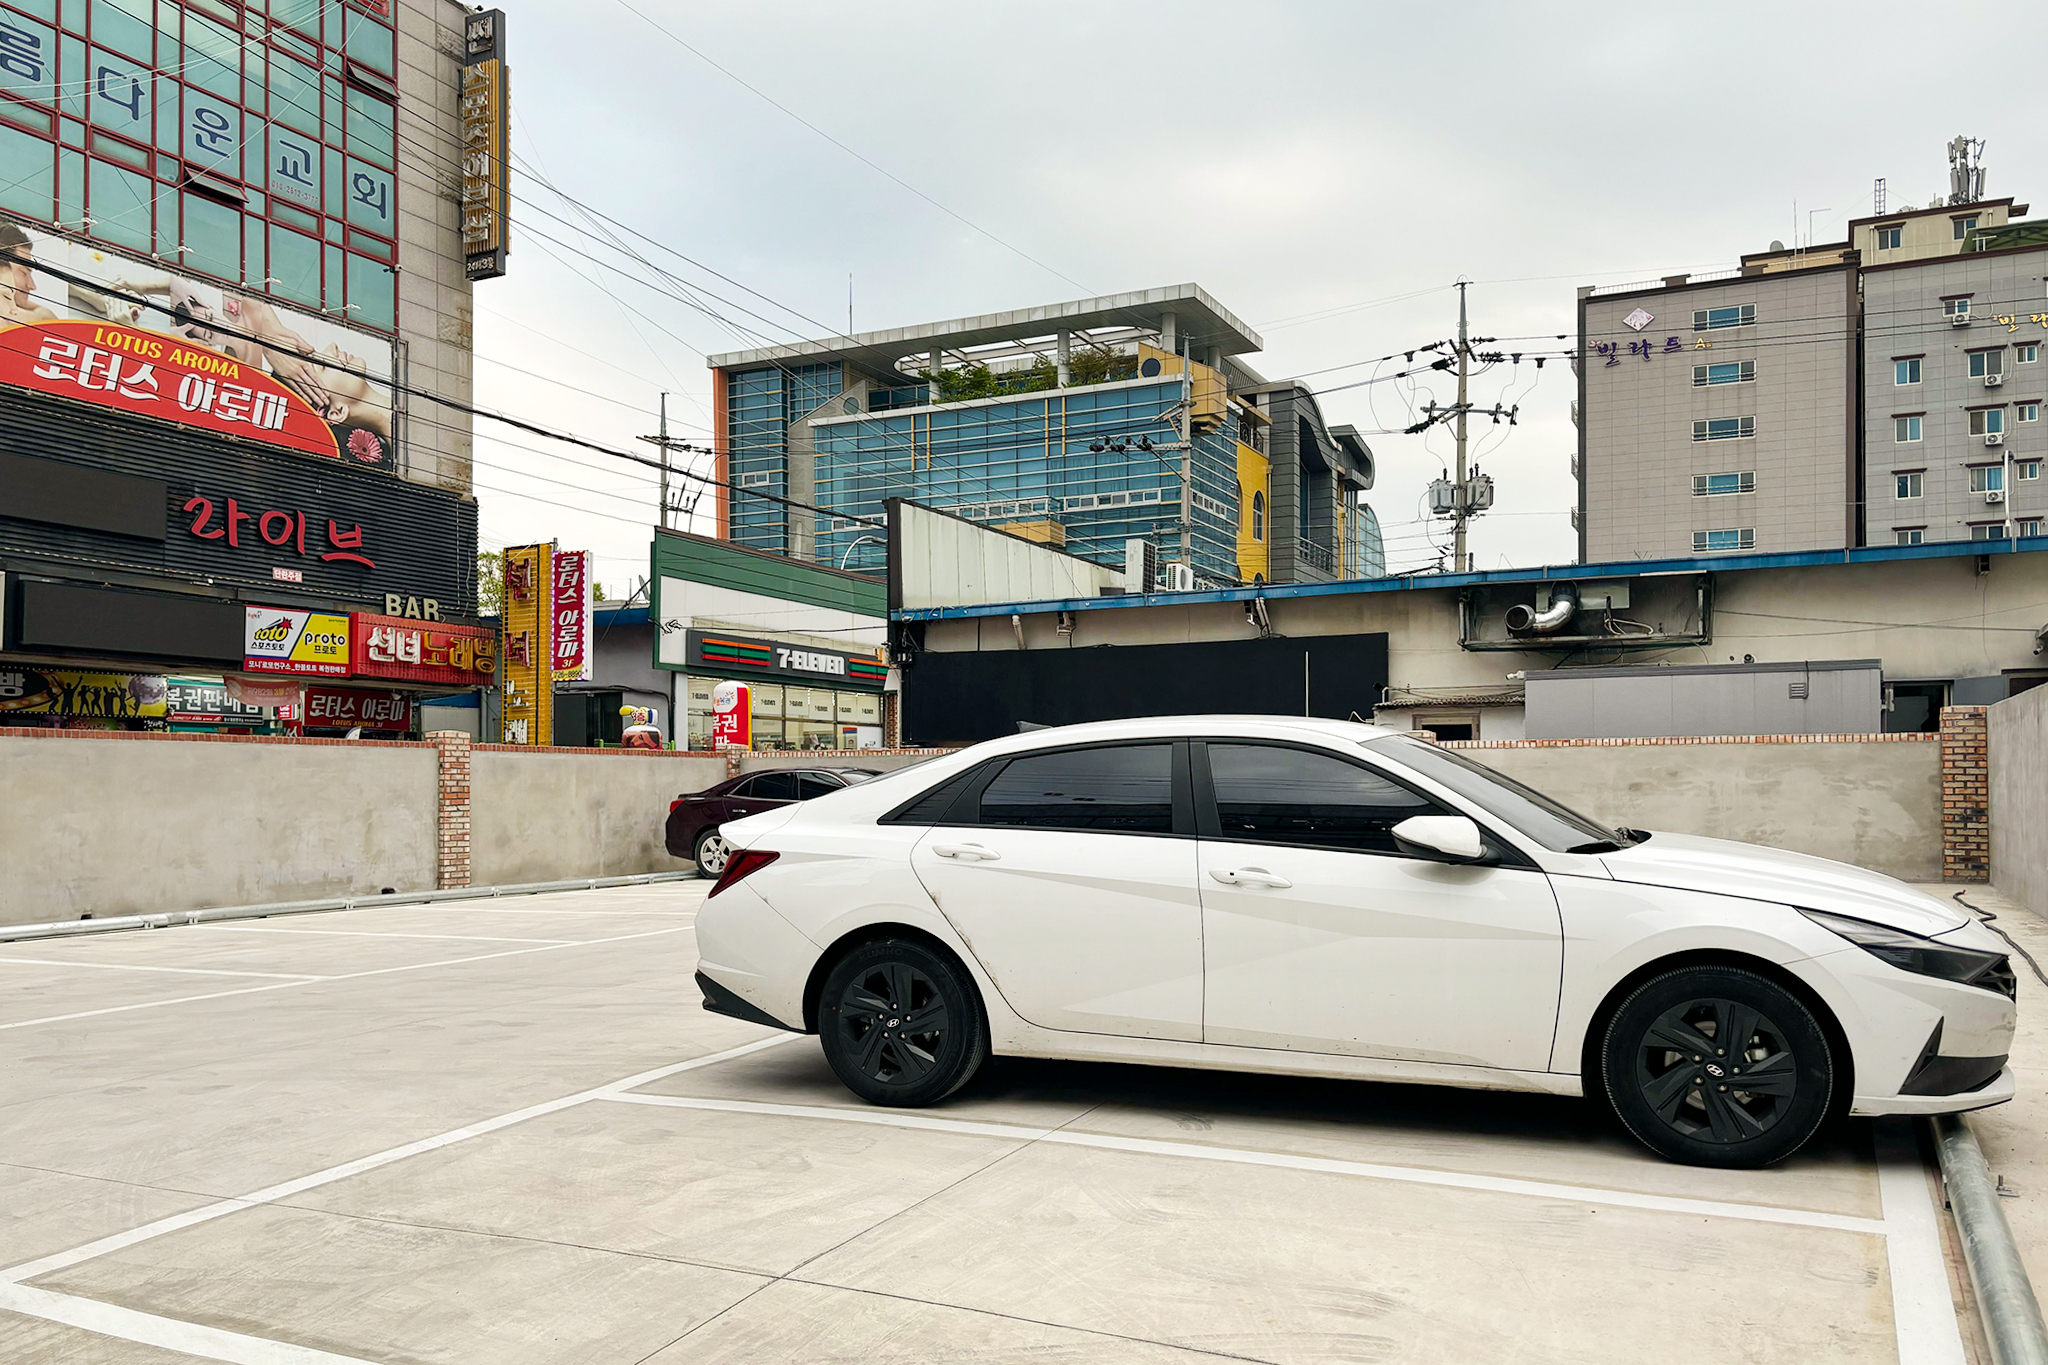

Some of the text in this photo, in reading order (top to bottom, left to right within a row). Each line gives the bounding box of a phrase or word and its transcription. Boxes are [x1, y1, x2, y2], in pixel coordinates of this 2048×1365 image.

[94, 328, 240, 380] LOTUS AROMA
[33, 336, 290, 431] 로터스 아로마
[183, 497, 376, 569] 라이브
[385, 593, 440, 621] BAR
[557, 555, 580, 658] 로터스 아로마
[254, 626, 347, 646] toto proto
[314, 645, 337, 655] 프로토
[562, 658, 575, 668] 3F
[309, 694, 356, 719] 로터스
[361, 697, 406, 722] 아로마
[713, 714, 738, 733] 복권
